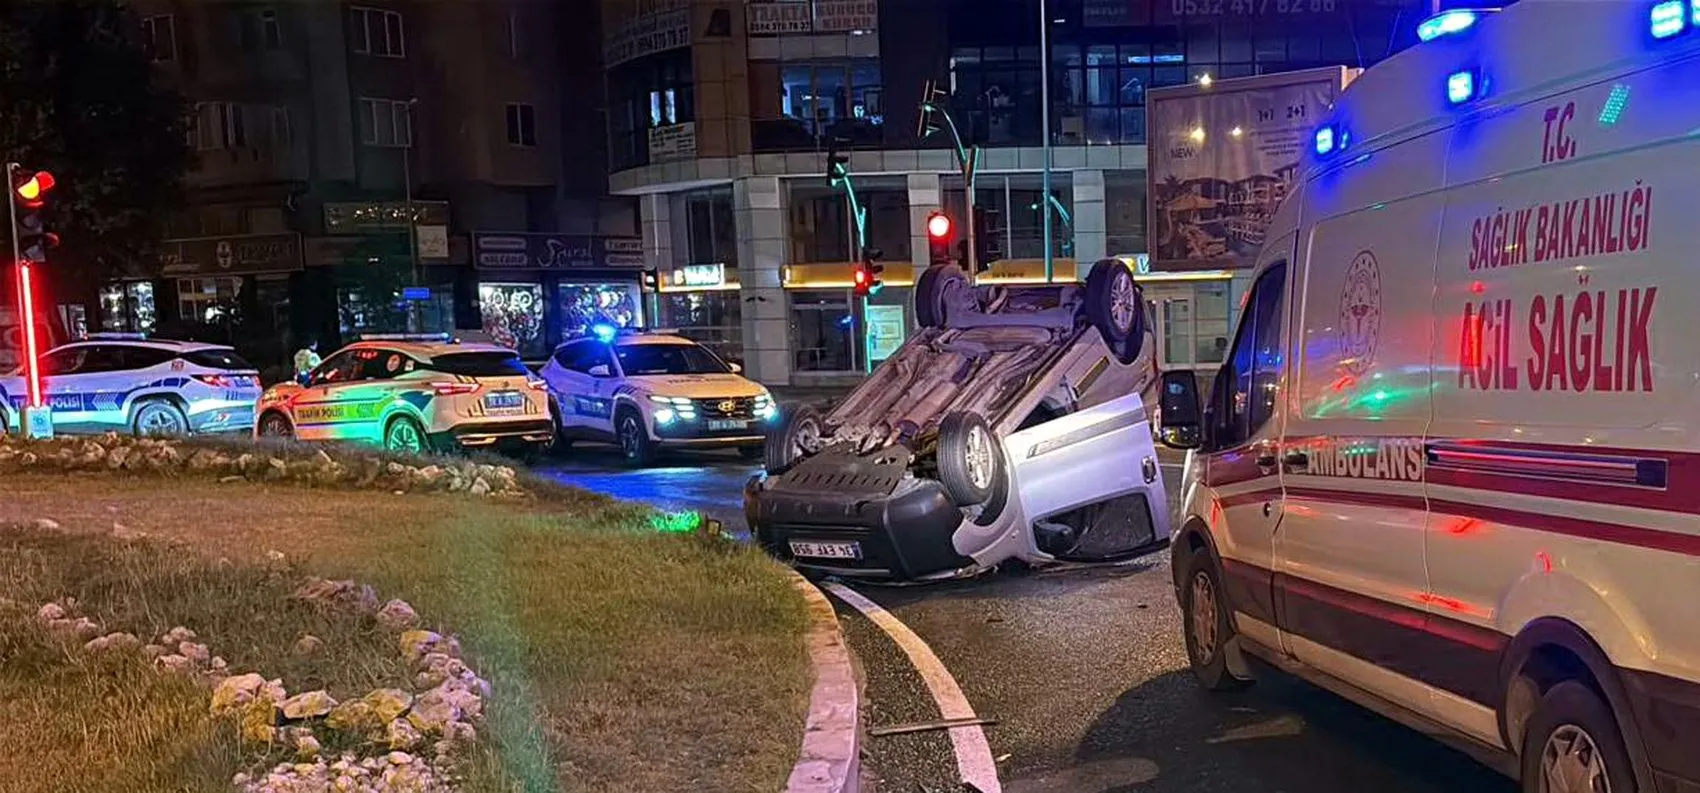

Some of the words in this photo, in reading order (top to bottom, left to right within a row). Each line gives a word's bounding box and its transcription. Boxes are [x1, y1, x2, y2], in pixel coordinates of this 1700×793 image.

[1542, 102, 1576, 163] T.C.
[1469, 207, 1532, 271] SAĞLIK
[1534, 178, 1652, 262] BAKANLIĞI
[1458, 299, 1518, 390] ACİL
[1527, 275, 1658, 392] SAĞLIK
[1307, 438, 1422, 480] AMBULANS
